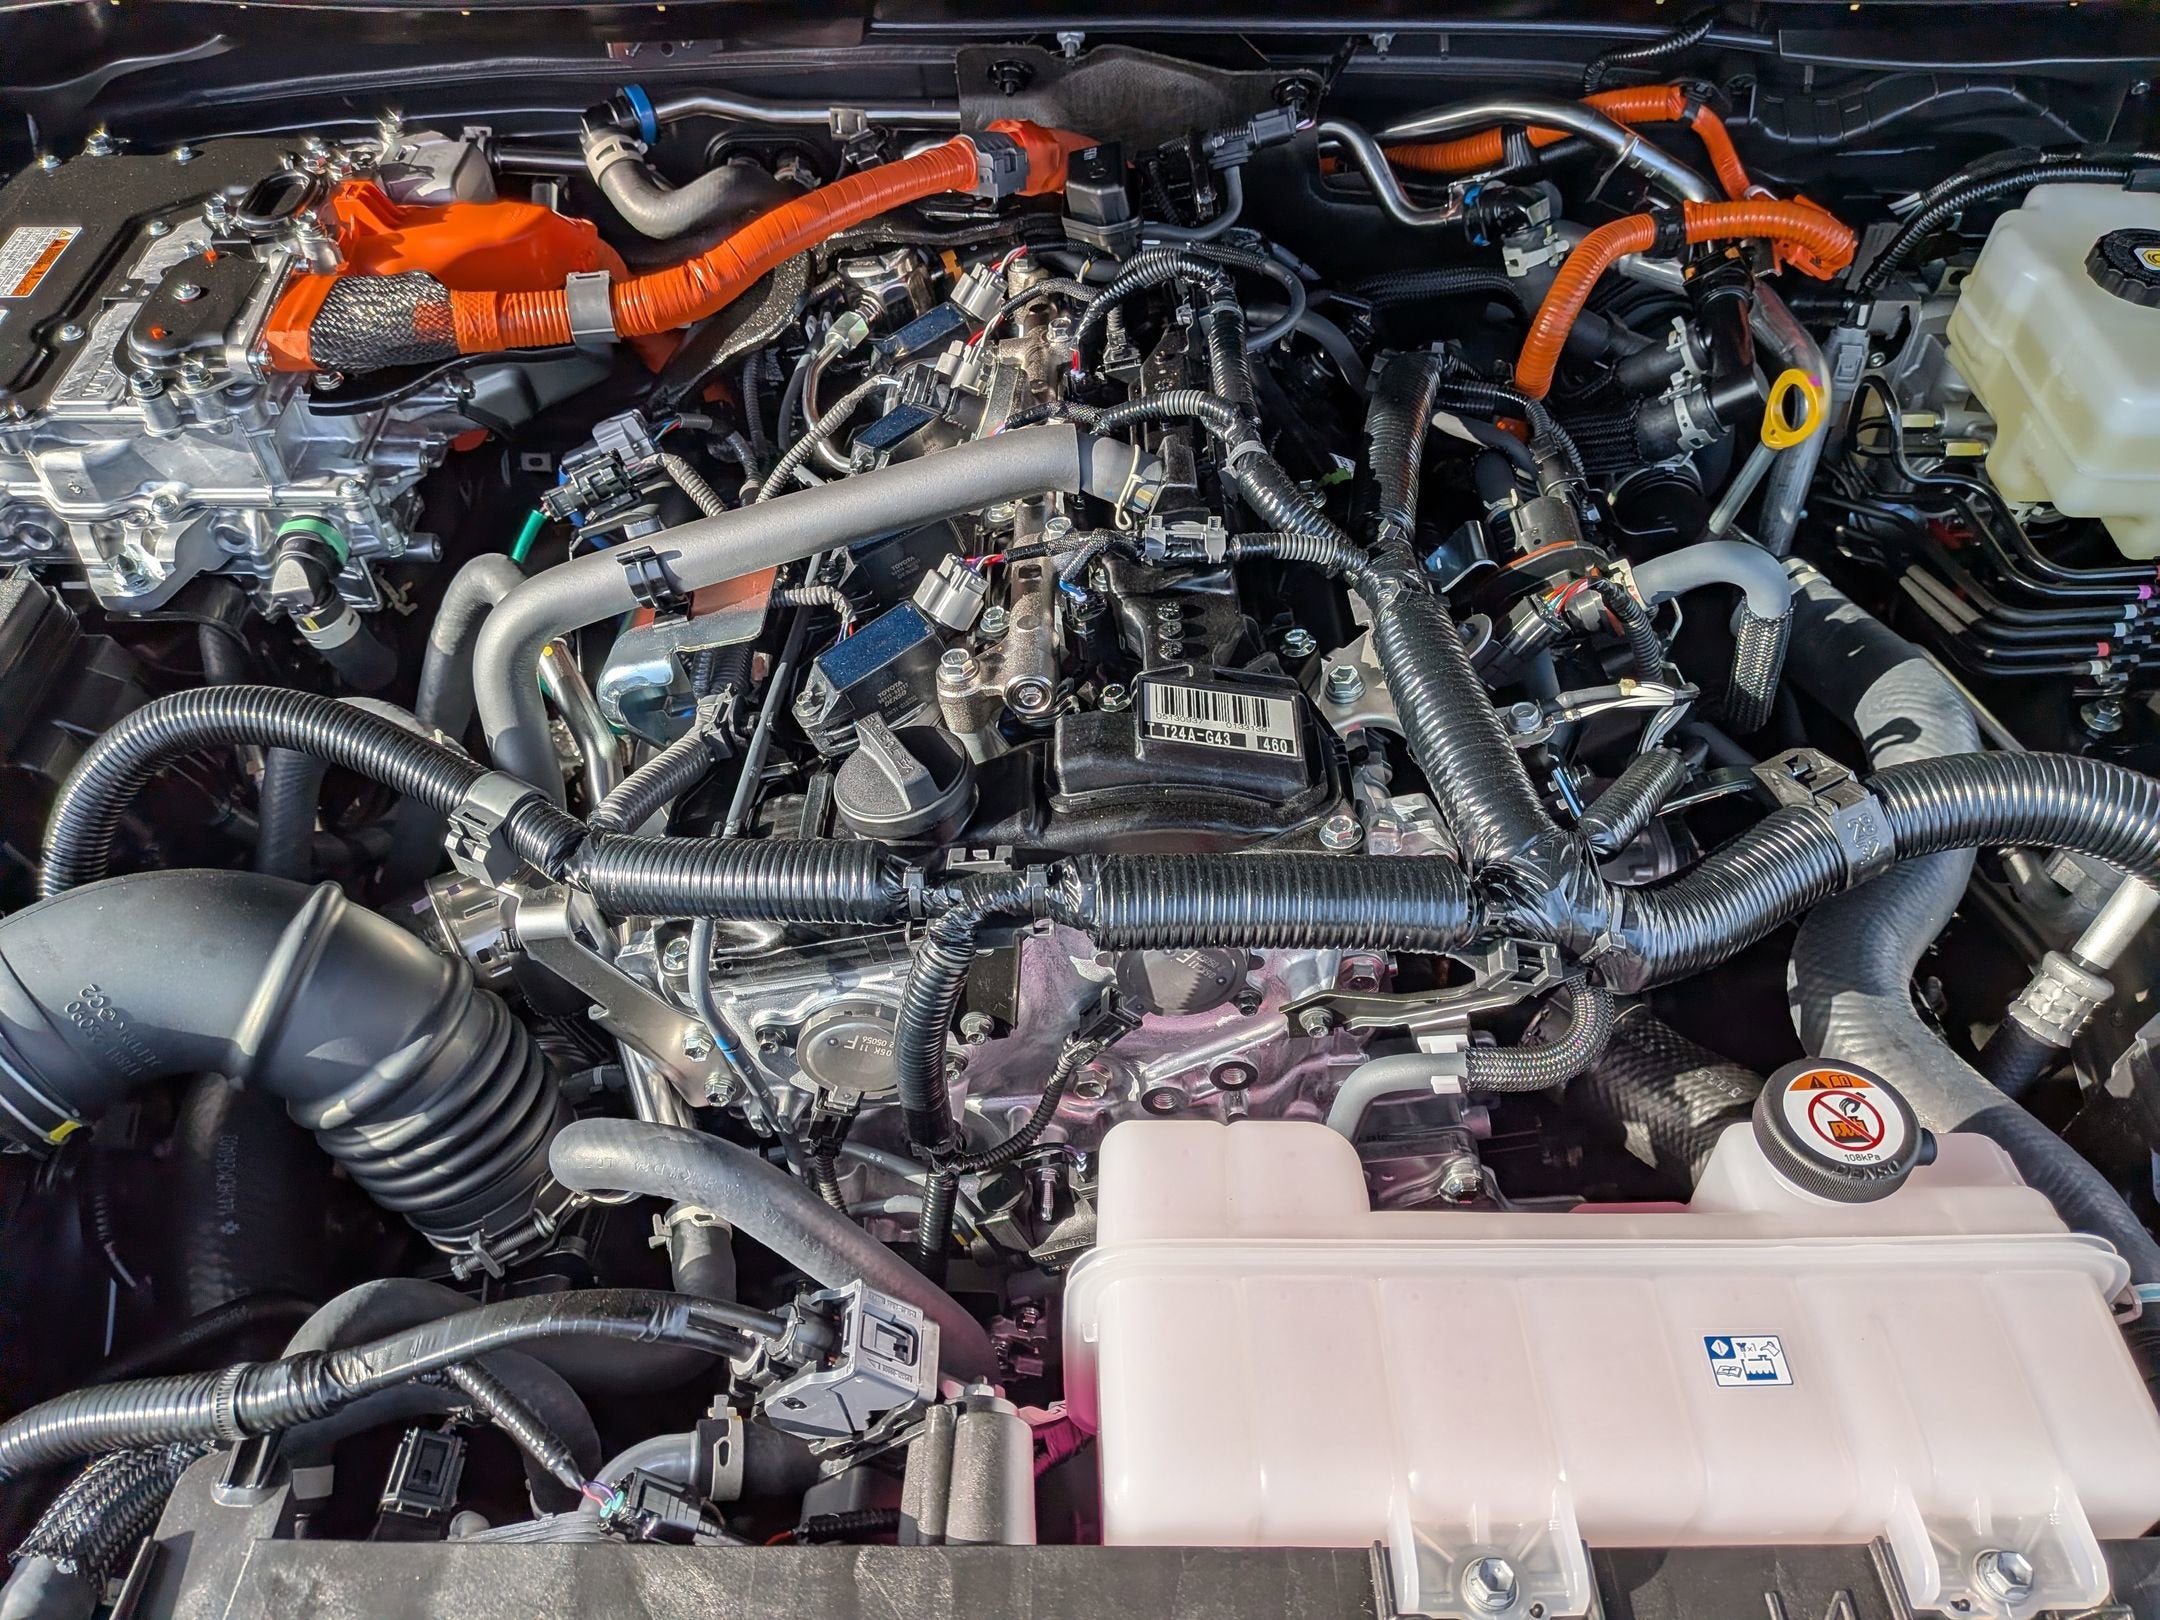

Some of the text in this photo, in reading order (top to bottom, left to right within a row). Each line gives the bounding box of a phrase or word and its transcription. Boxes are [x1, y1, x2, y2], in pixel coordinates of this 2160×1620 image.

[878, 681, 903, 698] TOYOTA
[884, 690, 907, 707] DENSO
[1155, 712, 1204, 724] 05130937
[1162, 724, 1231, 746] T24A-G43
[1263, 738, 1288, 753] 460
[843, 1035, 859, 1050] F
[1844, 1153, 1881, 1162] 108kPa
[1831, 1160, 1900, 1180] DENSO
